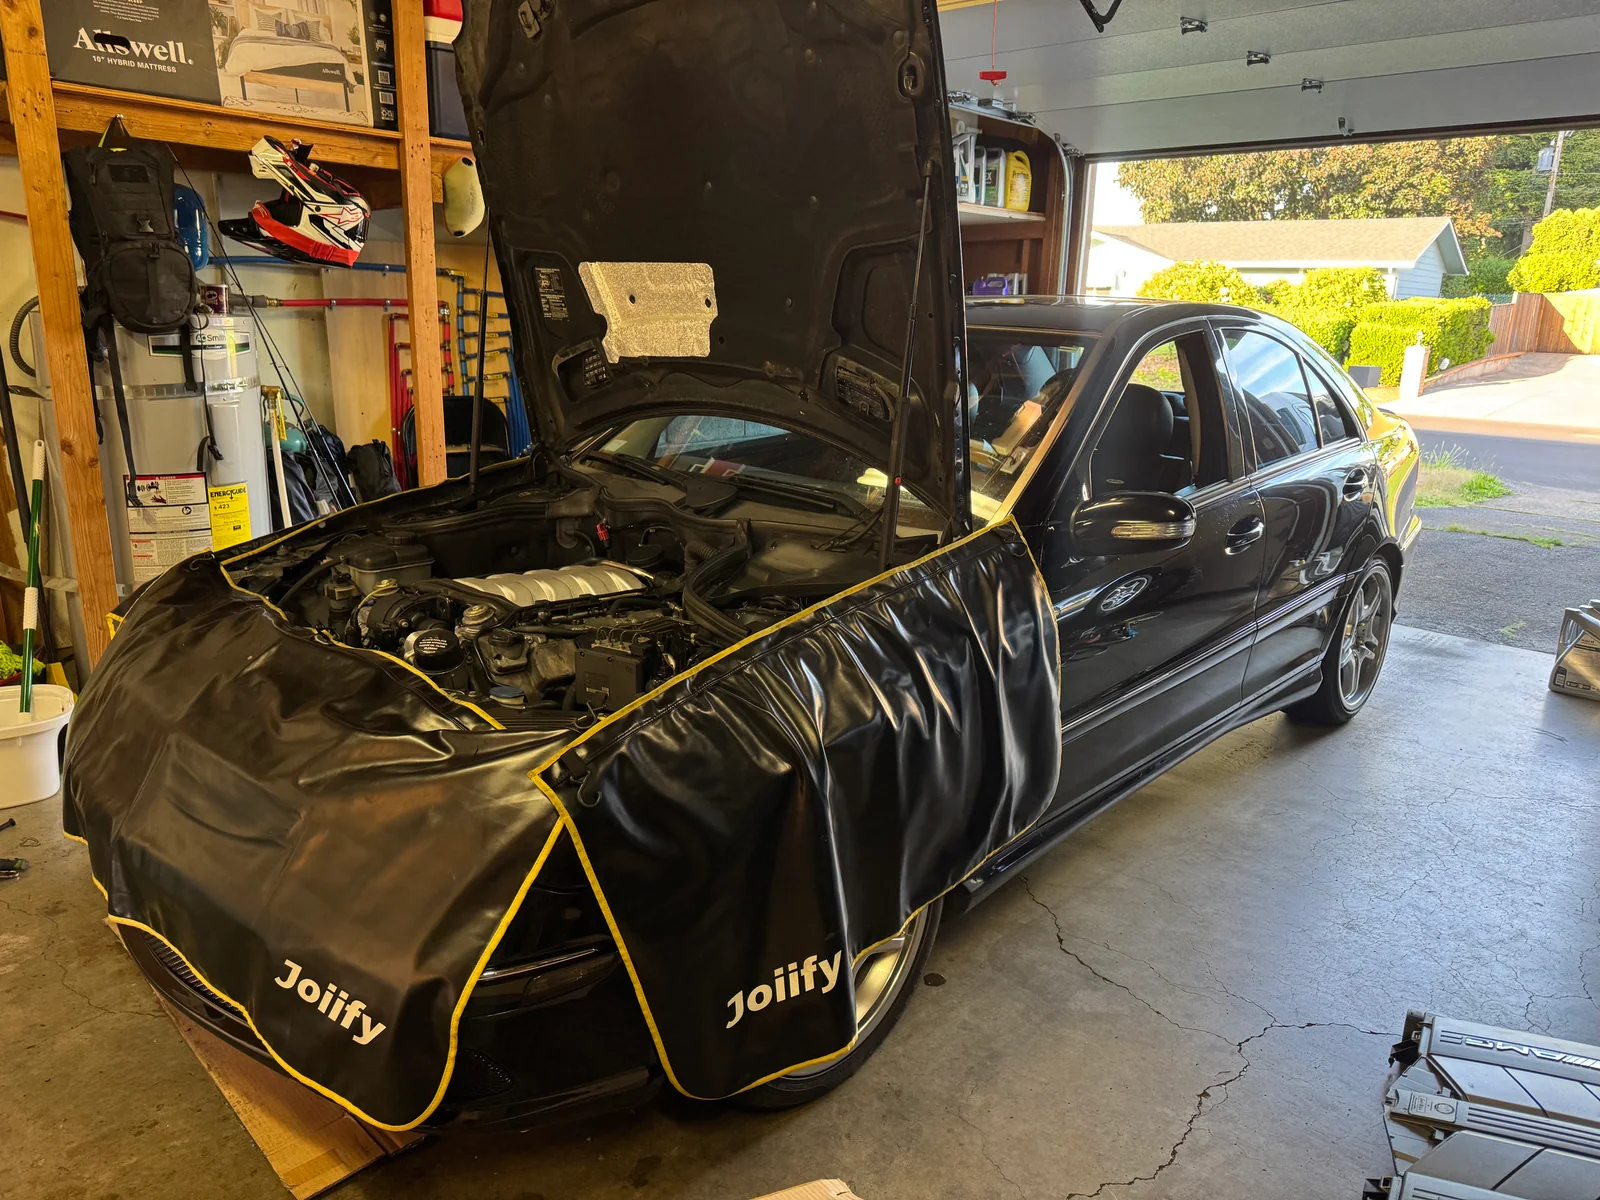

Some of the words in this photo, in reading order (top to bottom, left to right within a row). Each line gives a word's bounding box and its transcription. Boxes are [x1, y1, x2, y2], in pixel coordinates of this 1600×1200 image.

[107, 57, 136, 67] HYBRID
[137, 62, 177, 73] MATTRESS
[274, 959, 386, 1045] Joiify
[726, 950, 842, 1029] Joiify
